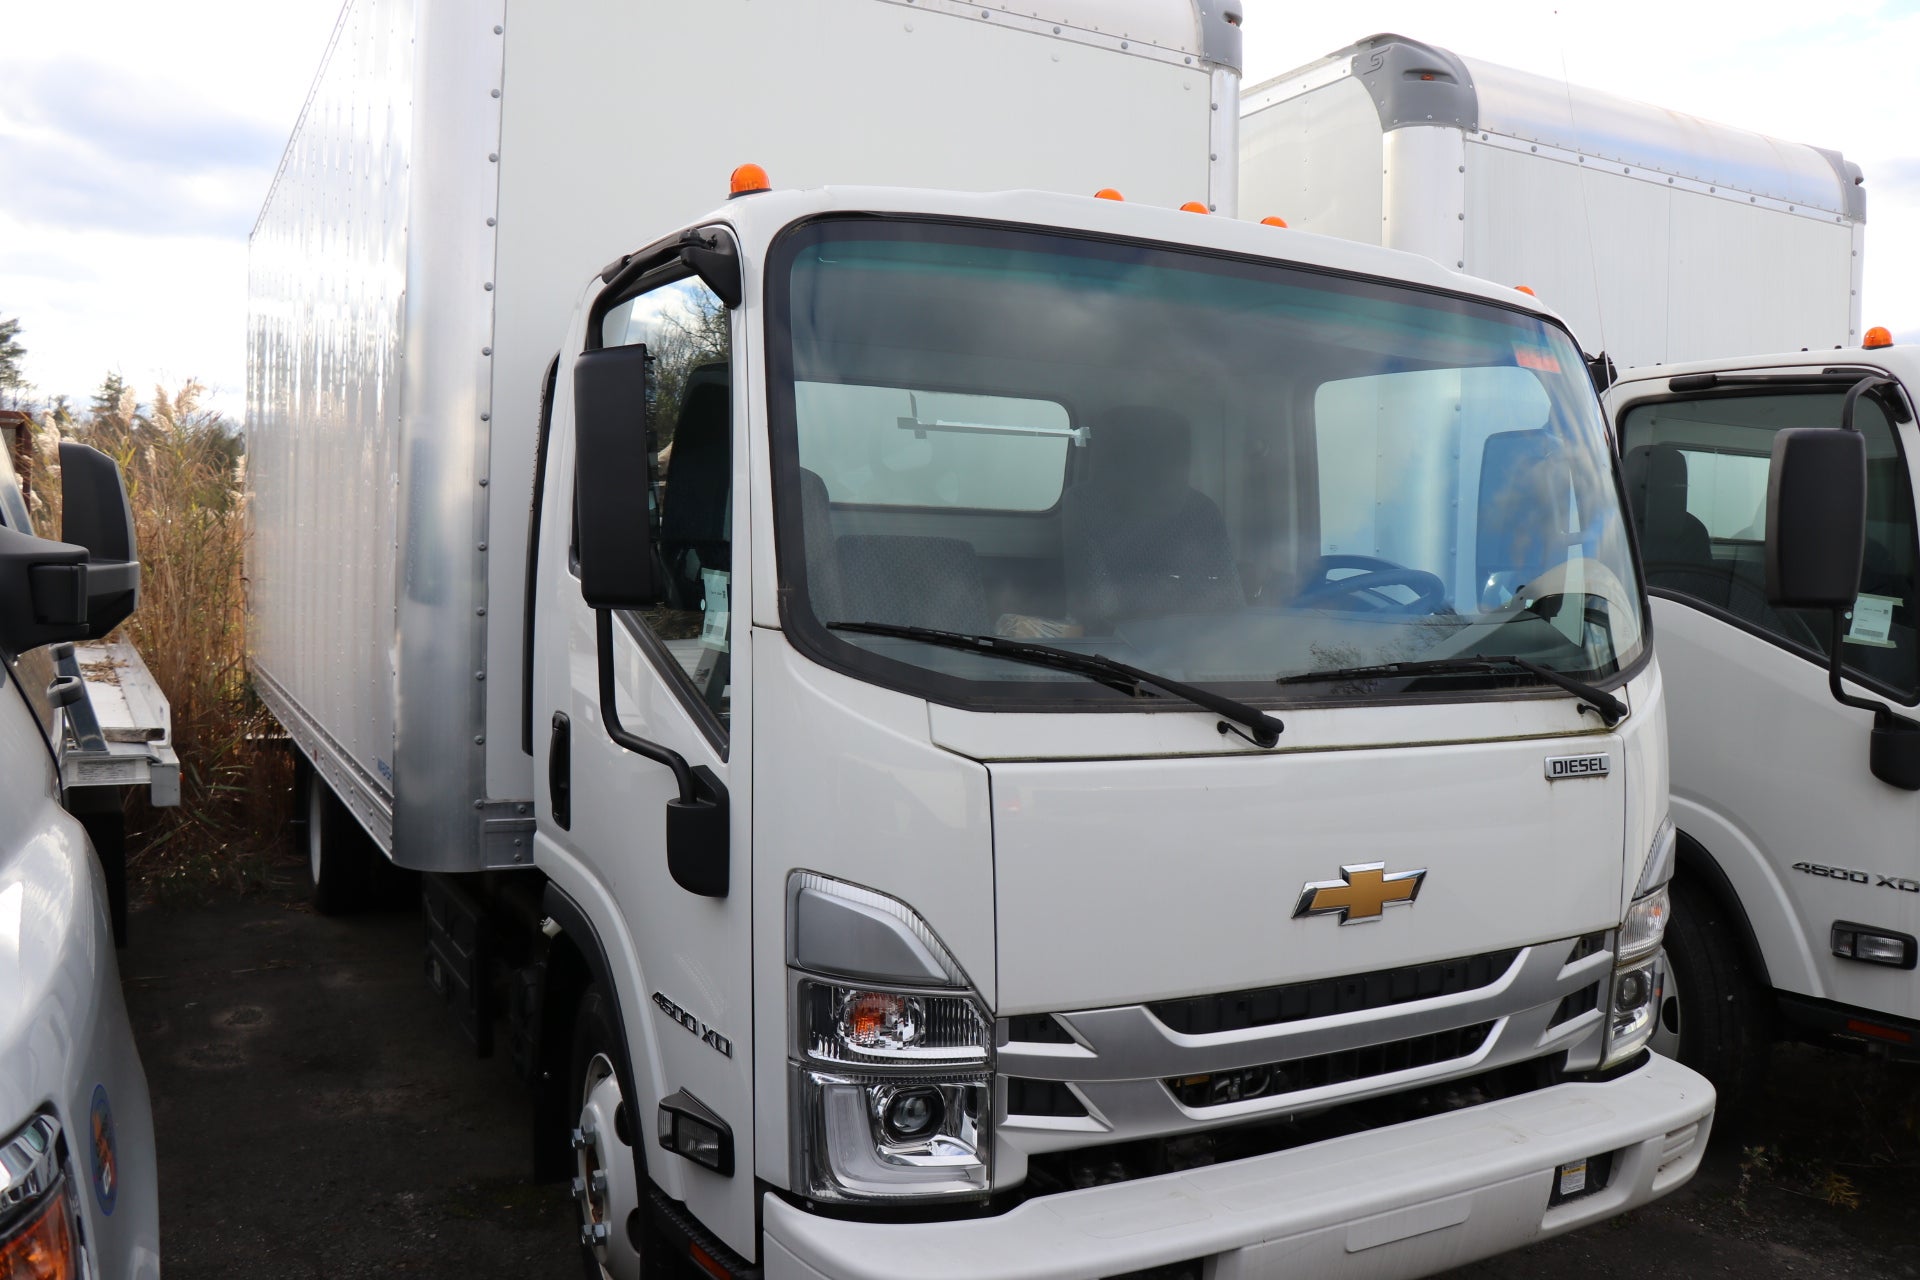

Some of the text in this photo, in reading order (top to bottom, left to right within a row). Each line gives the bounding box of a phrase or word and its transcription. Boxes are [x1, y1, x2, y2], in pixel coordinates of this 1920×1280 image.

[1552, 758, 1607, 775] DIESEL
[1791, 861, 1869, 885] 4500
[652, 991, 699, 1037] 4500
